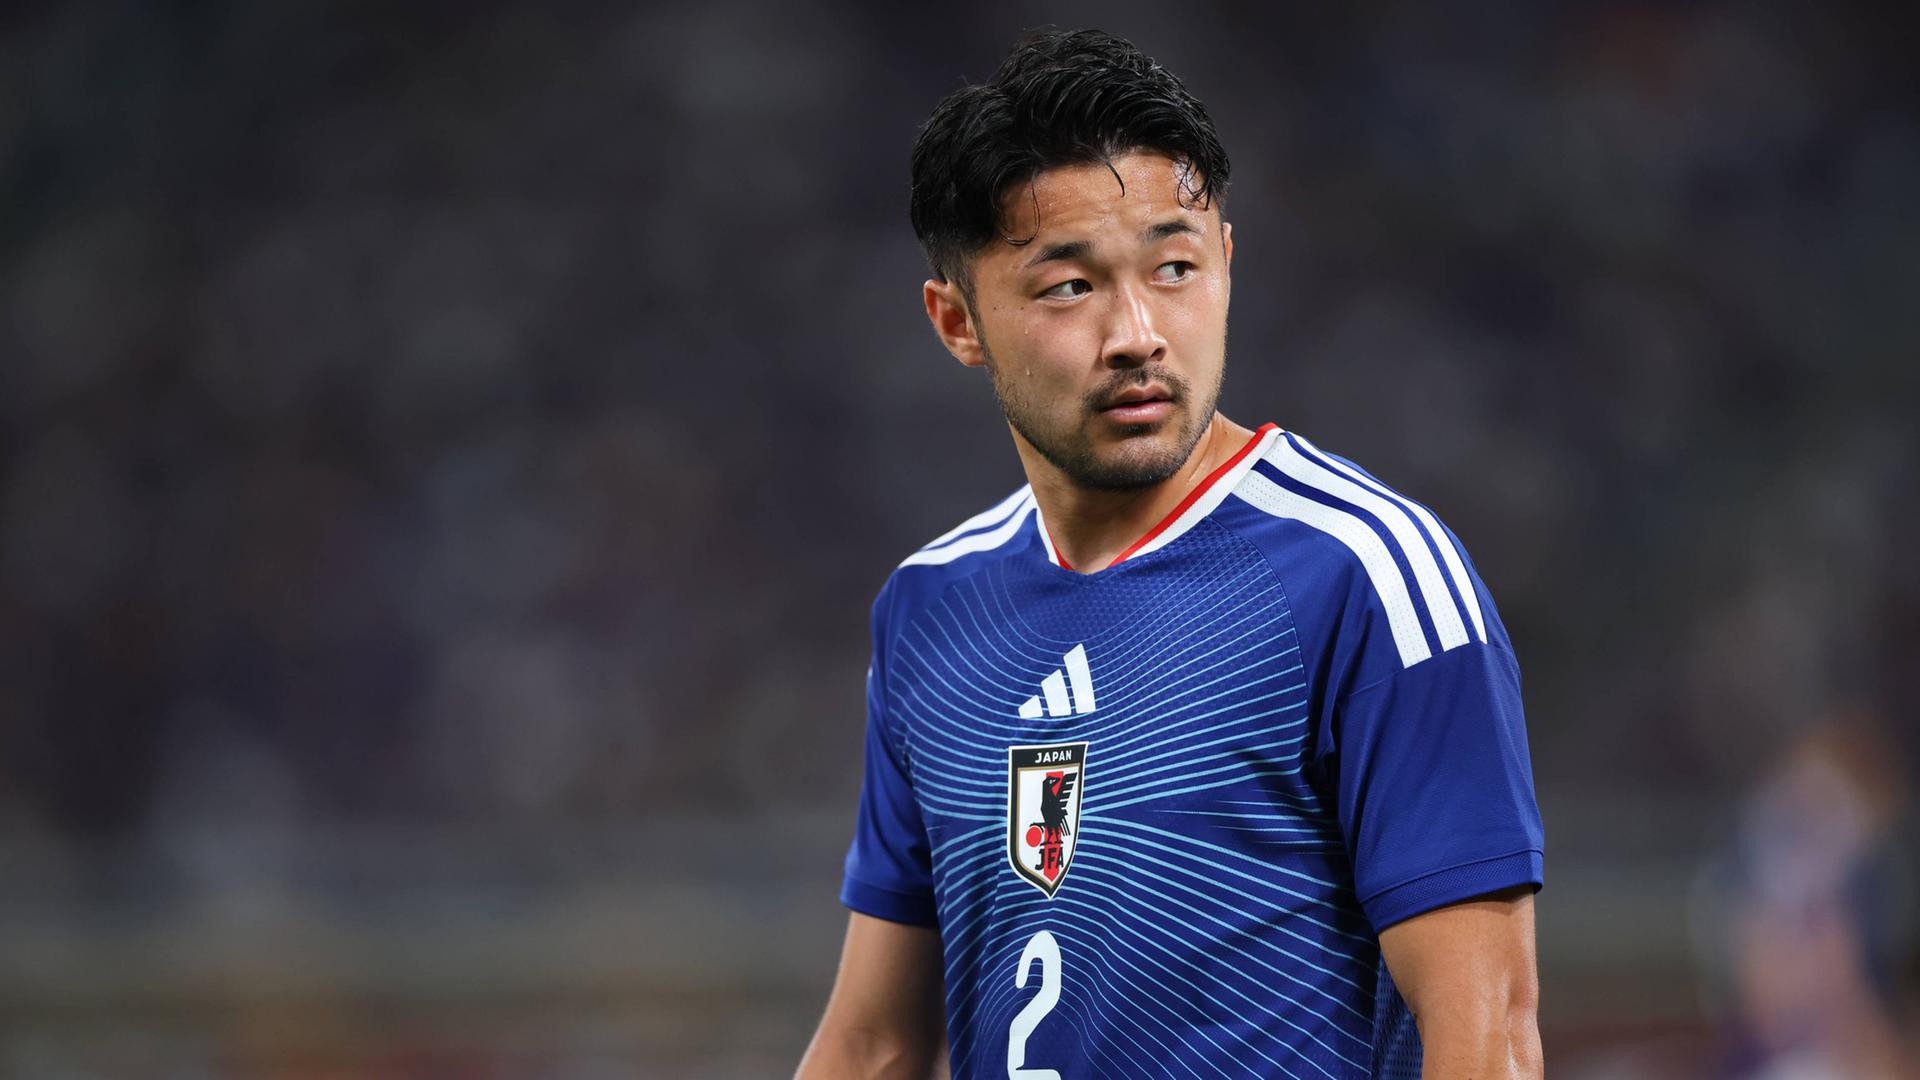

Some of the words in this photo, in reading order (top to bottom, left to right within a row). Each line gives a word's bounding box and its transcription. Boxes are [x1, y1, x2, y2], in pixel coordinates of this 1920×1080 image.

[1034, 749, 1072, 763] JAPAN
[1035, 847, 1064, 870] JFA
[1007, 929, 1062, 1080] 2
